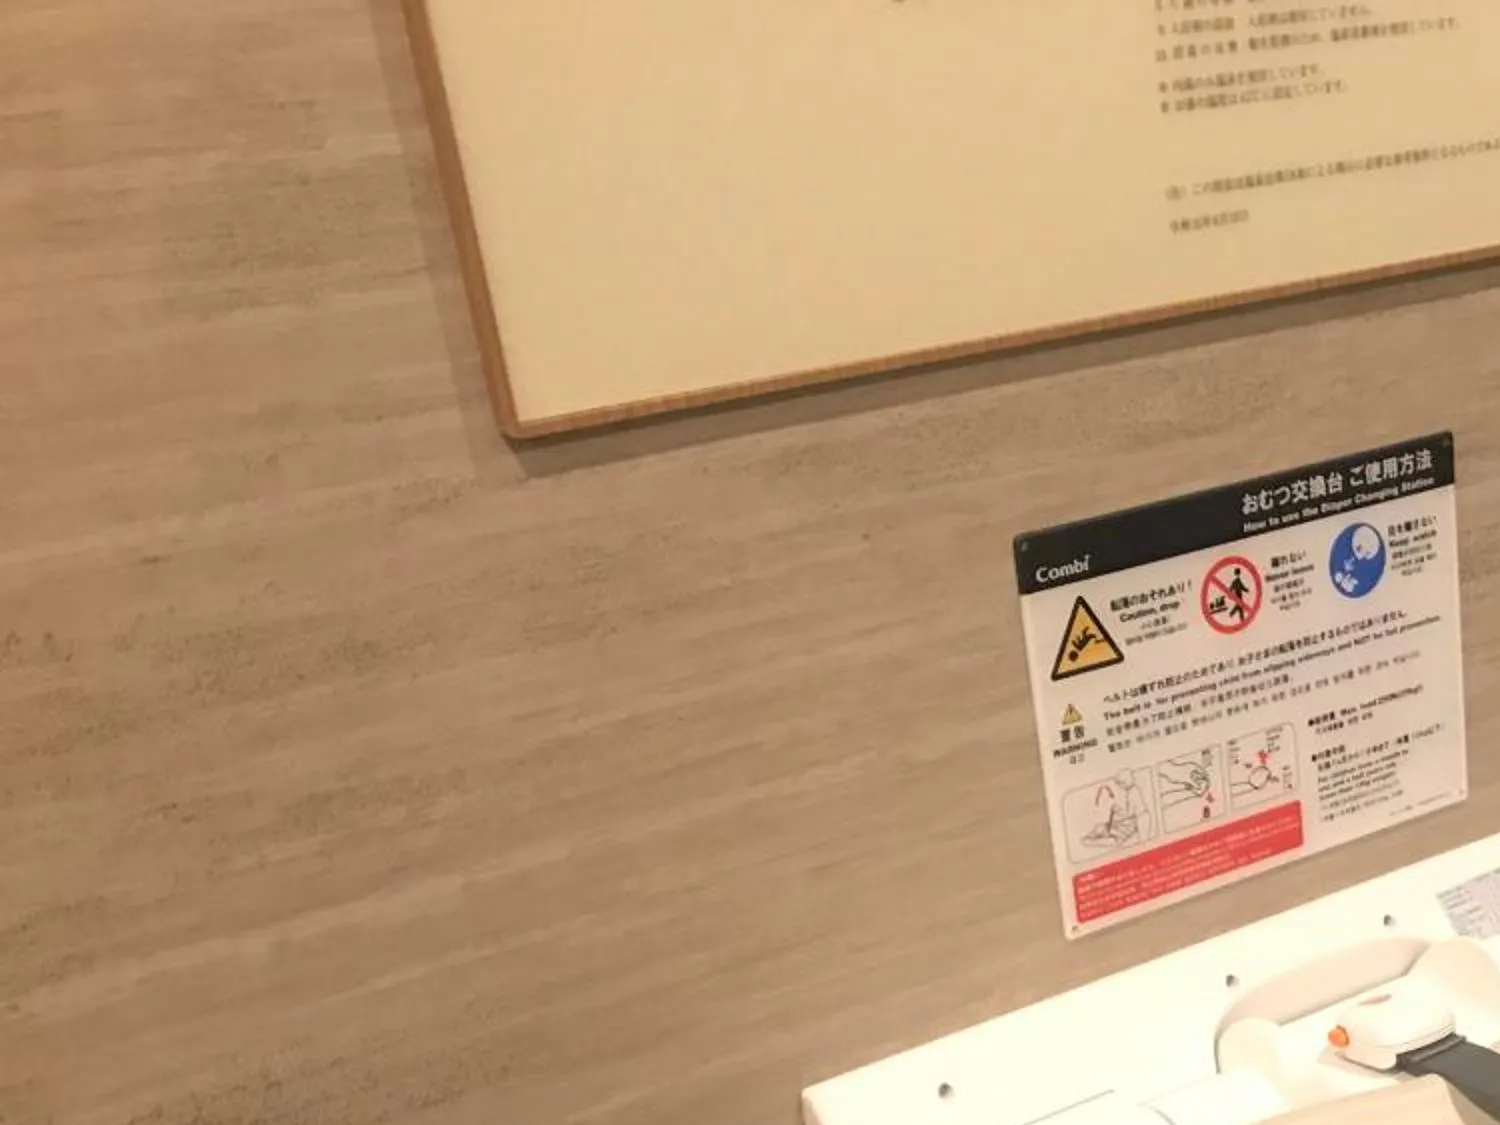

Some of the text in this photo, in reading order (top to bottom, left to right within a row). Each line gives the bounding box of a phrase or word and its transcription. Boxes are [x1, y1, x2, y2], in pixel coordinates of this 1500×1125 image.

[1242, 448, 1433, 515] おむつ交換台 ご使用方法
[1243, 519, 1266, 533] How
[1269, 516, 1280, 526] to
[1282, 512, 1299, 522] use
[1302, 506, 1318, 517] the
[1354, 486, 1399, 503] Changing
[1402, 477, 1435, 492] Station
[1036, 555, 1090, 582] Combi
